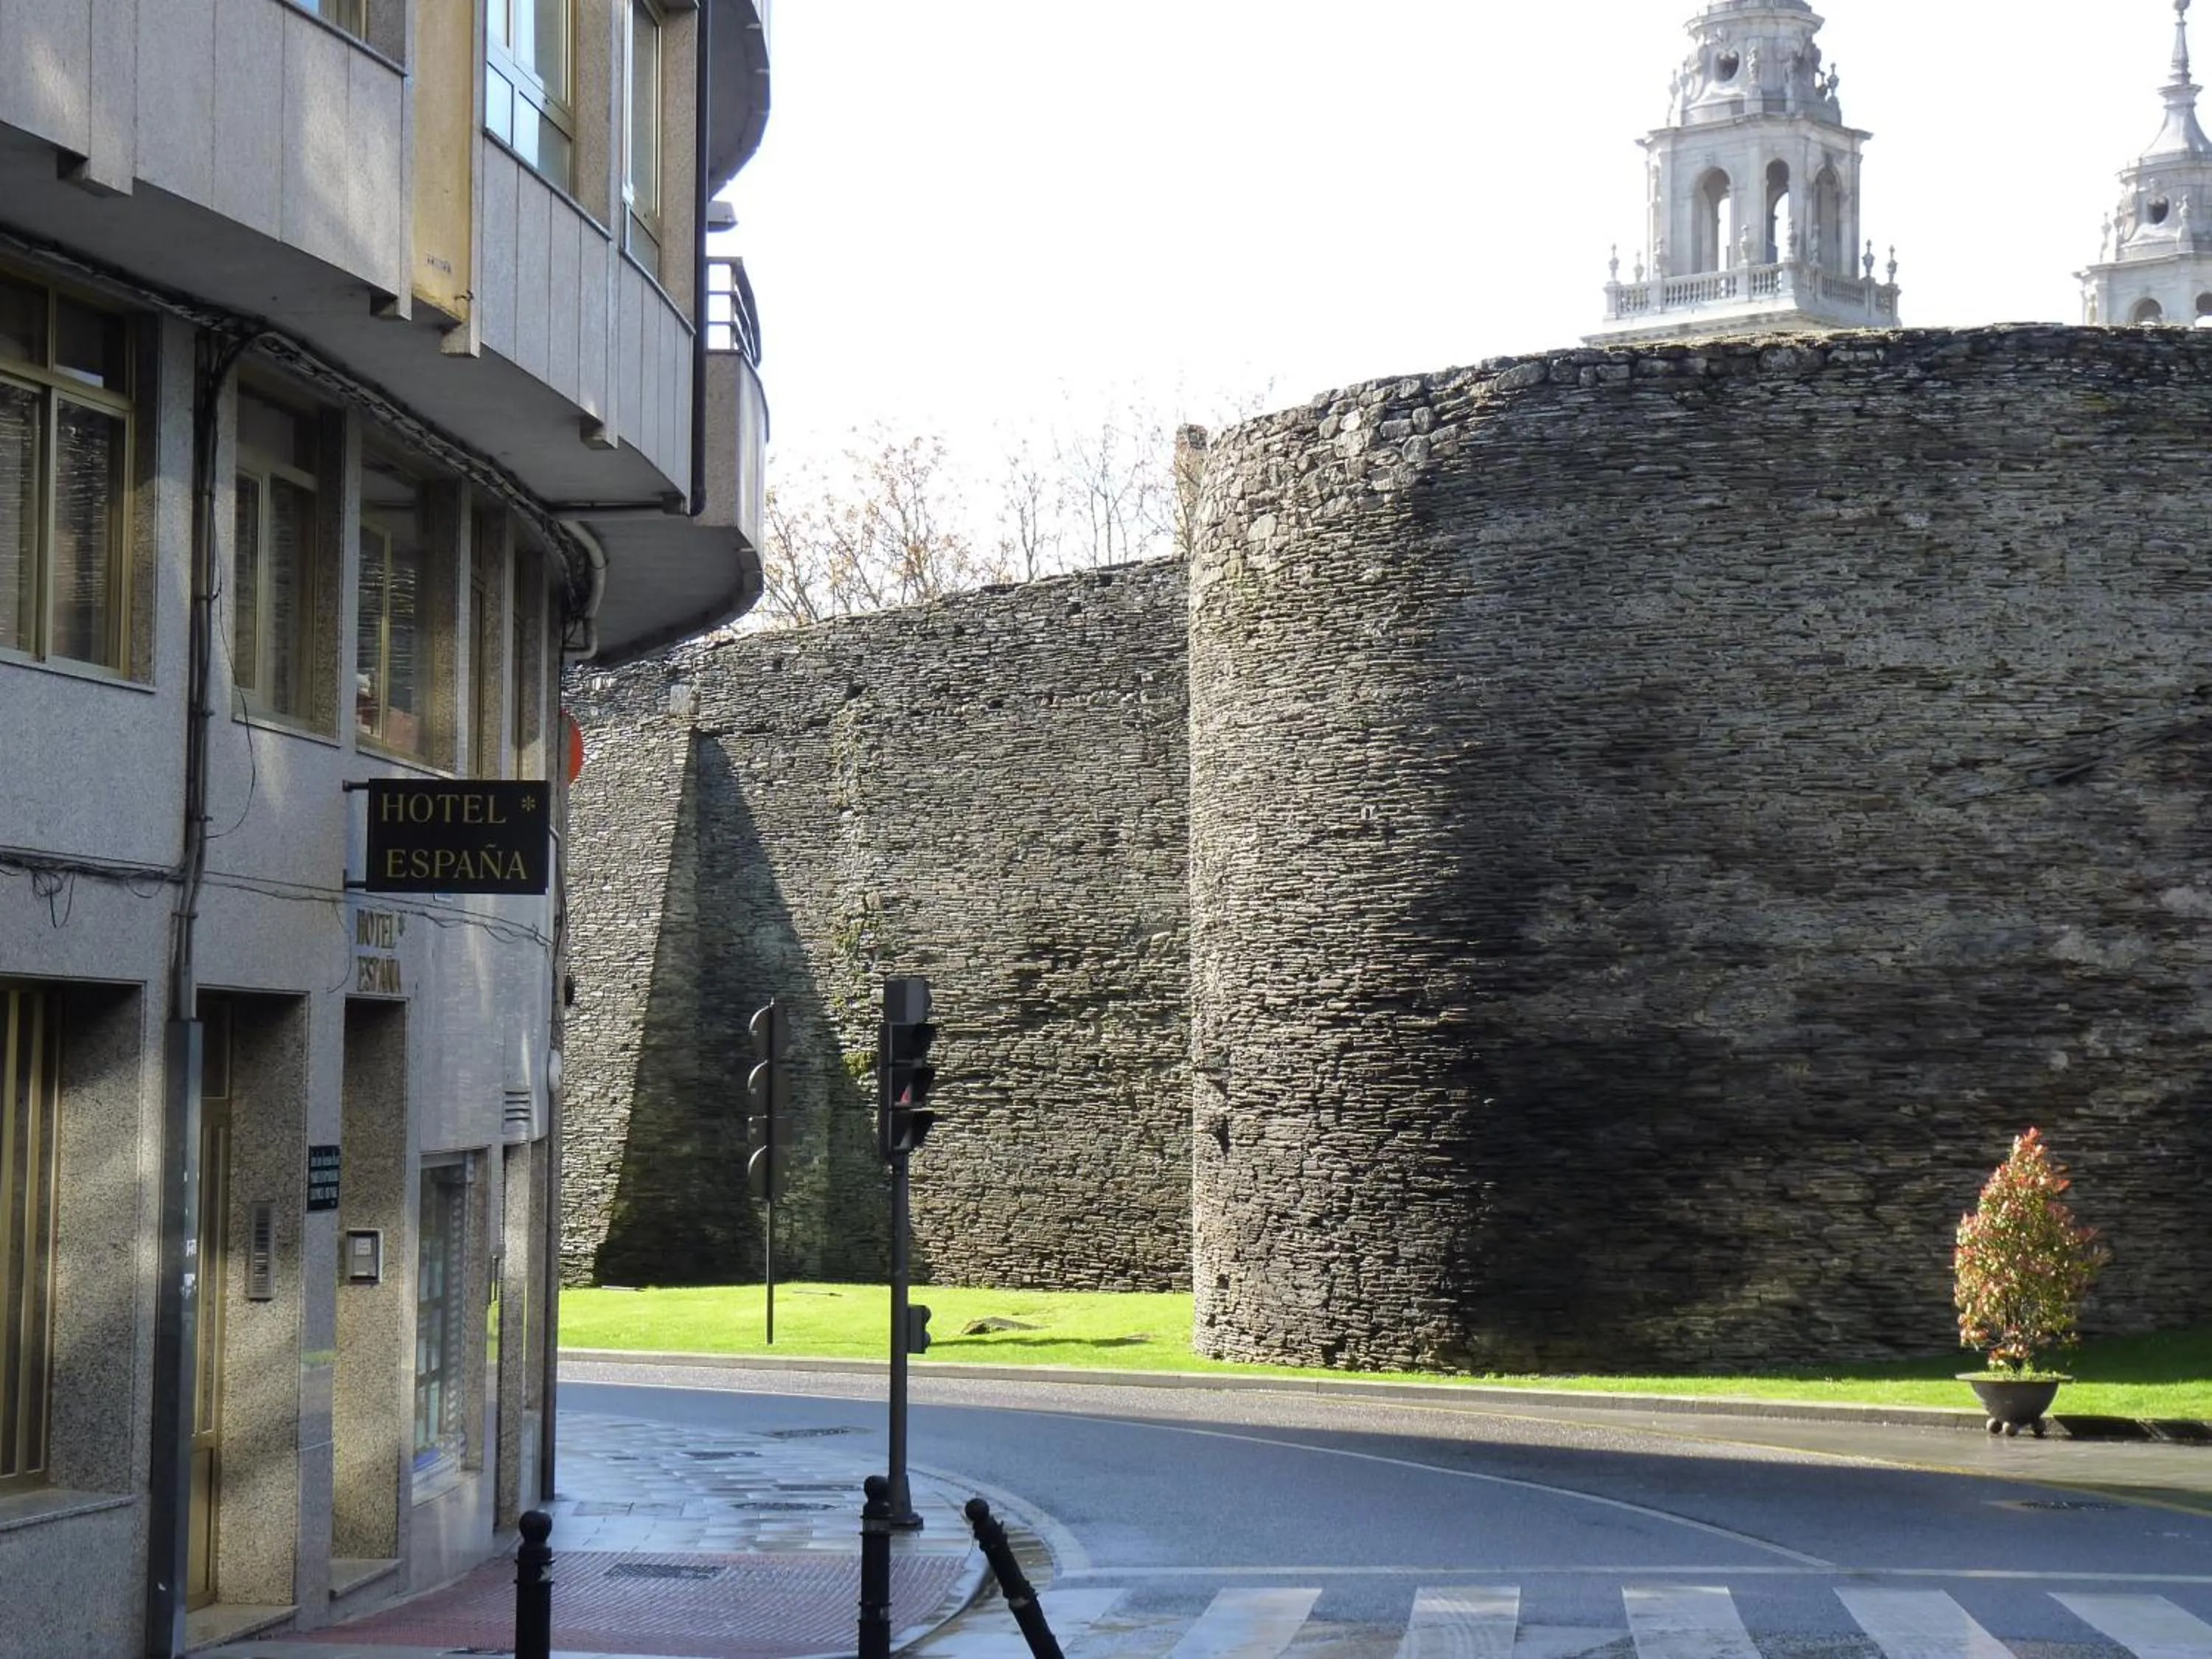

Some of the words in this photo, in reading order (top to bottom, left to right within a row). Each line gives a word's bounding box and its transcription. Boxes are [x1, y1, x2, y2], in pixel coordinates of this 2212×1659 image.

[380, 792, 507, 824] HOTEL
[386, 844, 529, 880] ESPAÑA
[357, 908, 397, 949] HOTEL
